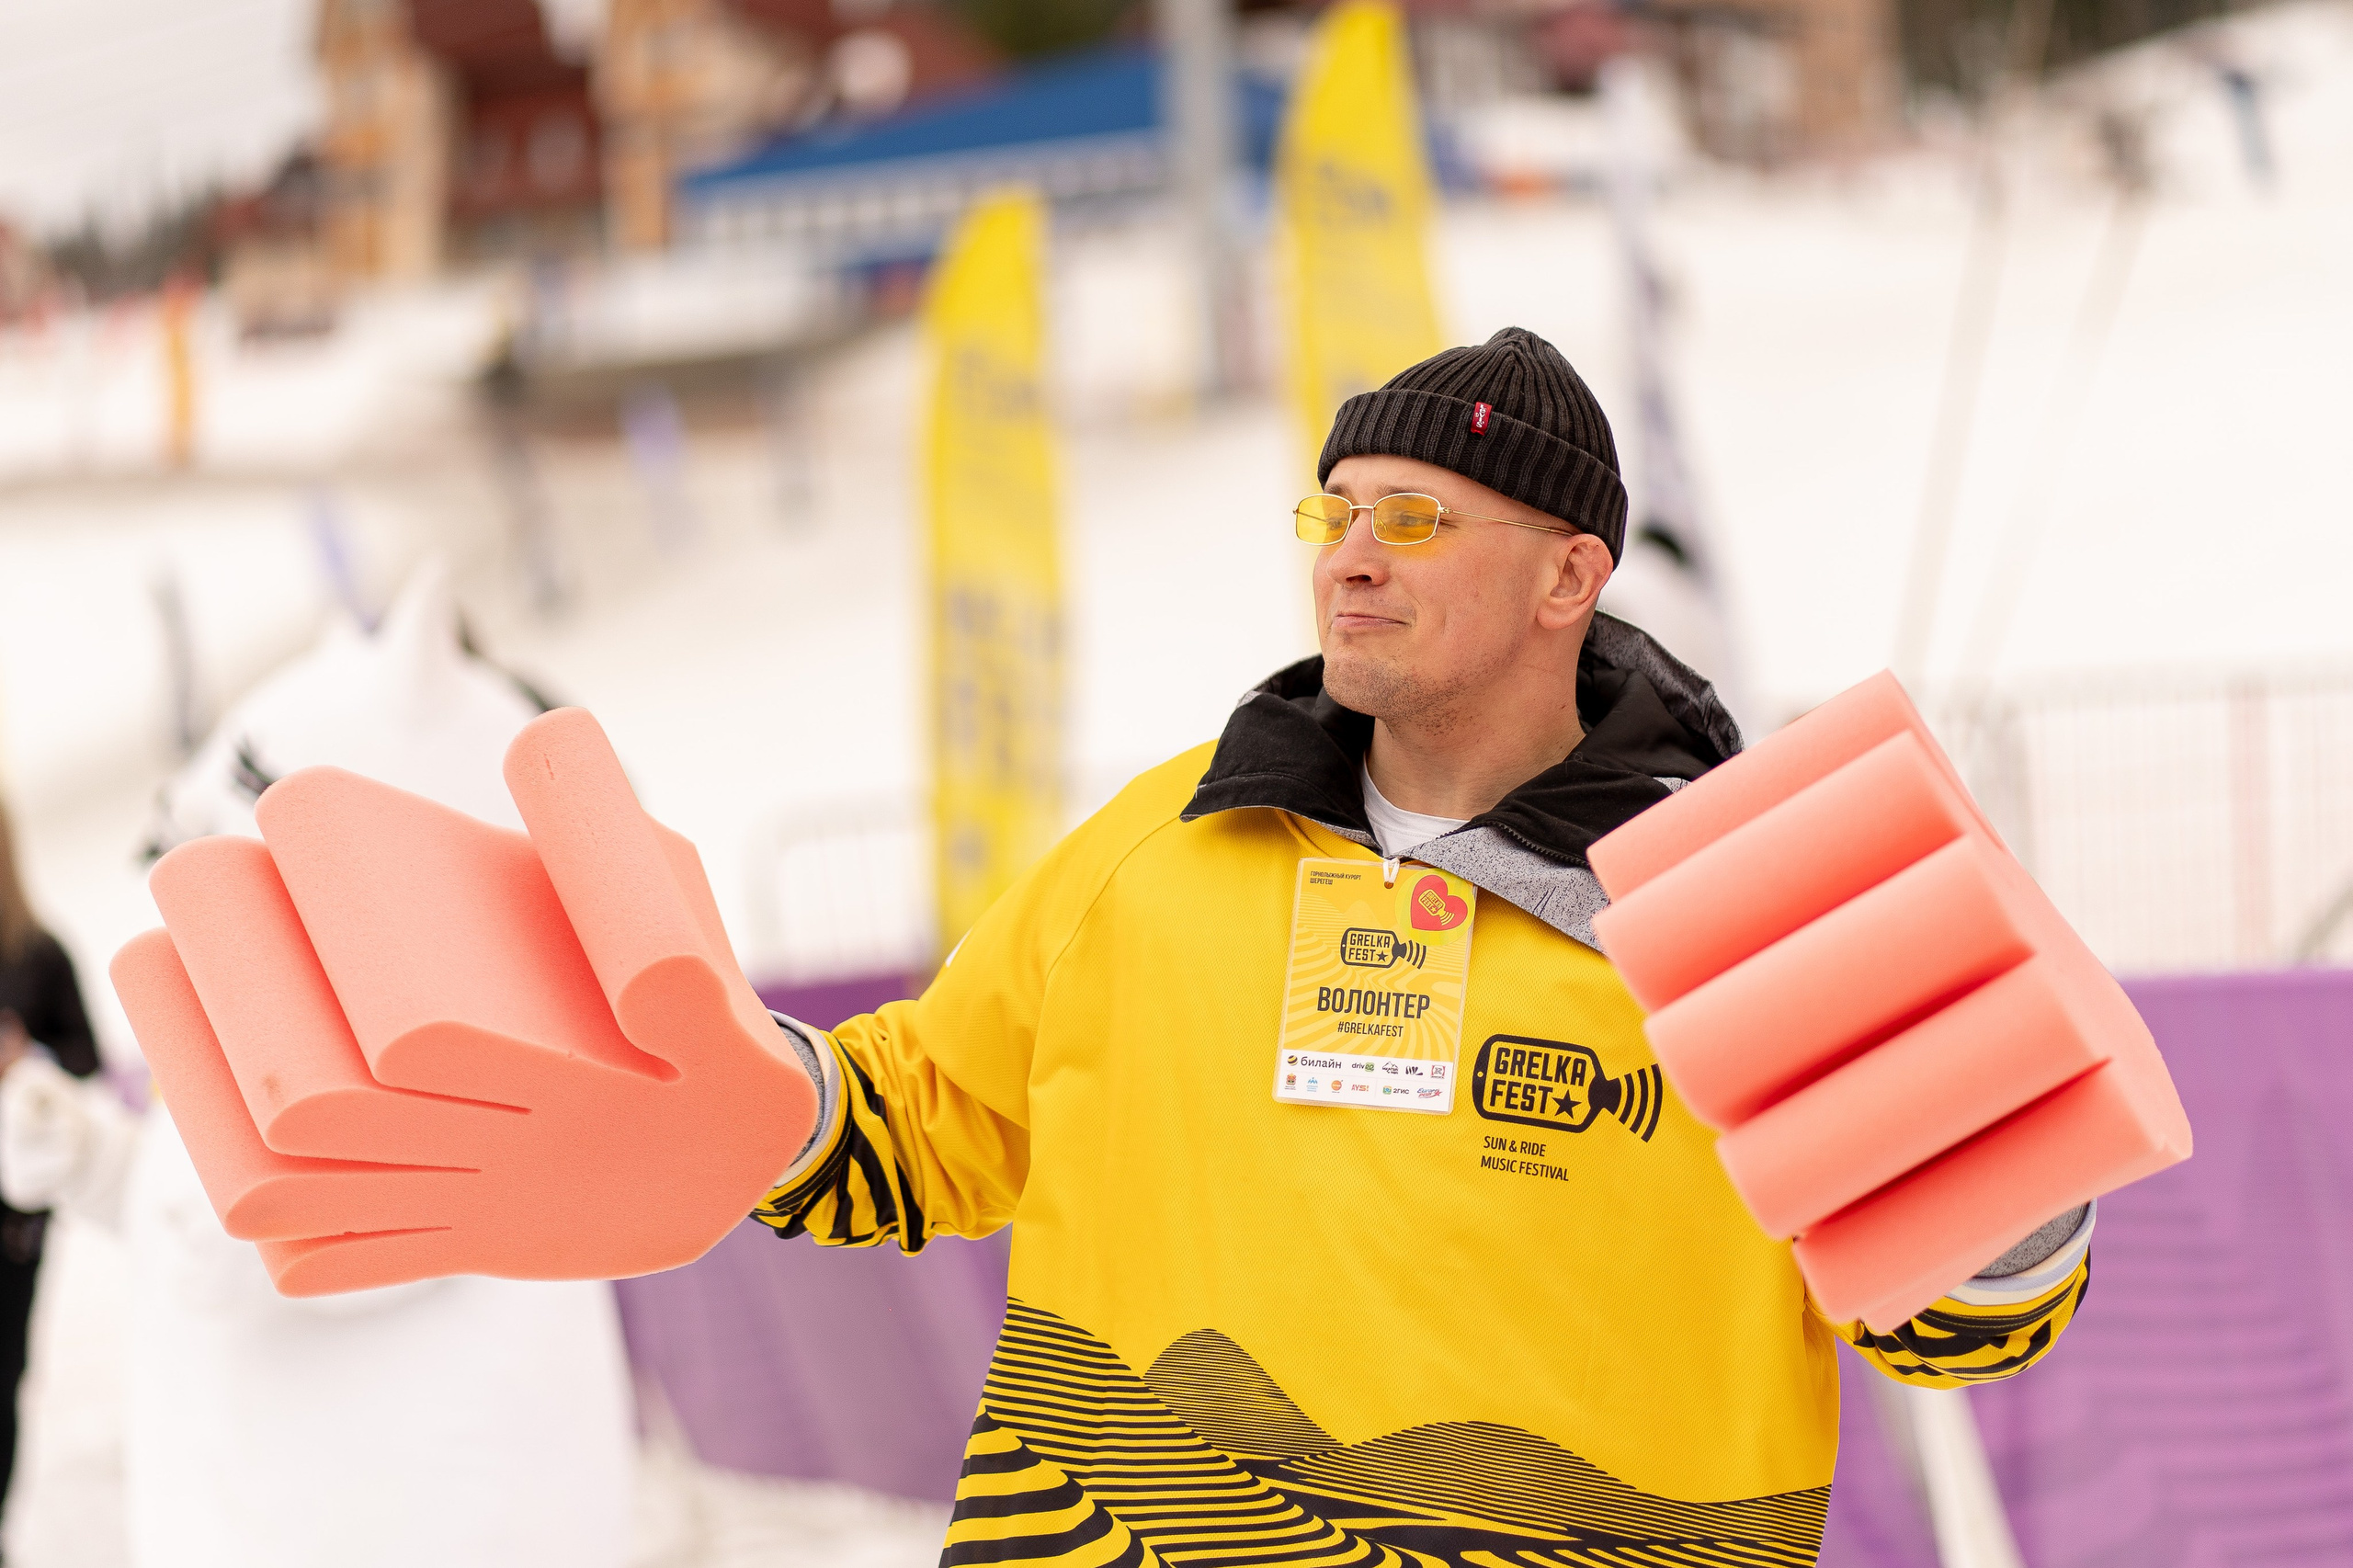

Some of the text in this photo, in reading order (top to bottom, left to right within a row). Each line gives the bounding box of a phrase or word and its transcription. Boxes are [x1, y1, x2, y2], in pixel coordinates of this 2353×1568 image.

[1350, 933, 1391, 949] GRELKA
[1348, 948, 1376, 961] FEST
[1317, 986, 1430, 1019] ВОЛОНТЕР
[1337, 1021, 1404, 1037] #GRELKAFEST
[1301, 1056, 1342, 1069] билайн
[1494, 1047, 1587, 1086] GRELKA
[1490, 1078, 1553, 1114] FEST
[1483, 1135, 1546, 1157] SUN & RIDE
[1481, 1155, 1569, 1182] MUSIC FESTIVAL
